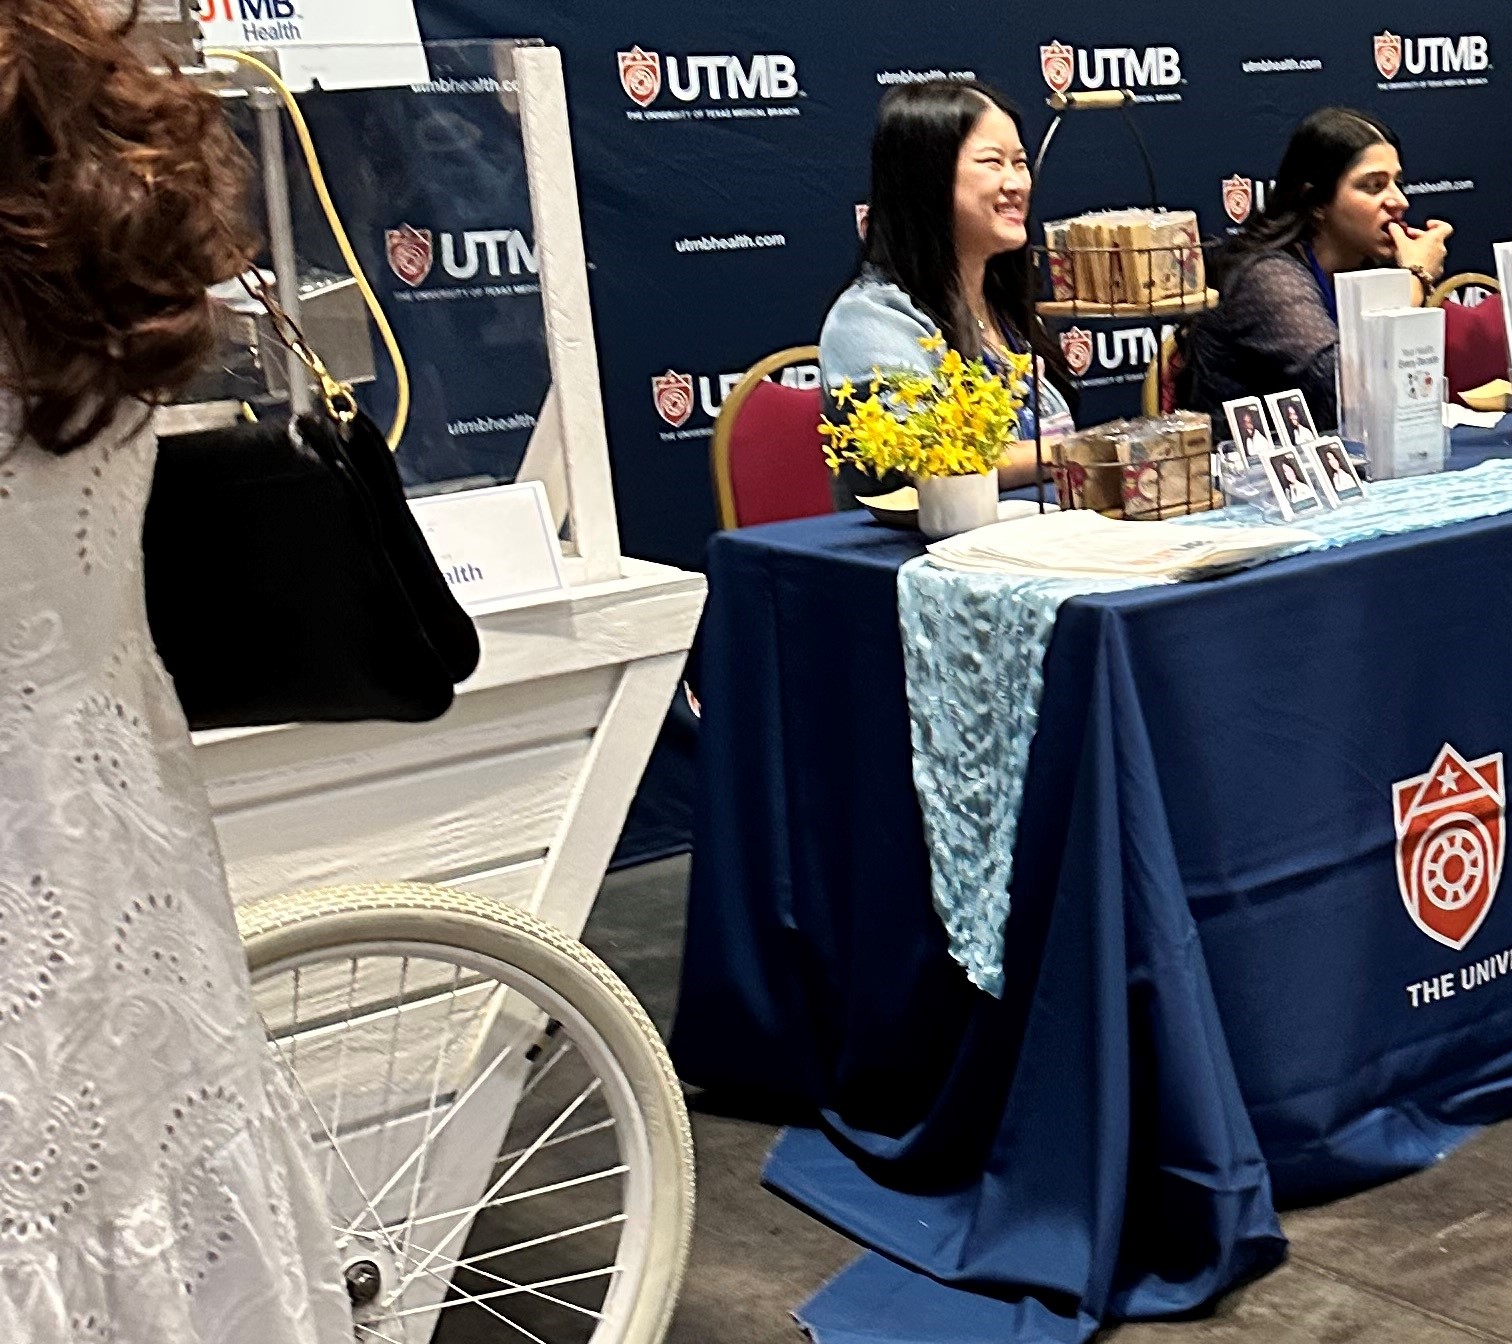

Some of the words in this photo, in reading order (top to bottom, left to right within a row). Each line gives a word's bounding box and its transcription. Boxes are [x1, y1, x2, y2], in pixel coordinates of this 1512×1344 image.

[243, 23, 301, 42] Health
[1078, 47, 1181, 89] UTMB
[1405, 36, 1488, 74] UTMB
[666, 55, 798, 101] UTMB
[441, 229, 540, 279] UTM
[676, 233, 786, 253] utmbhealth.com
[1406, 973, 1455, 1008] THE
